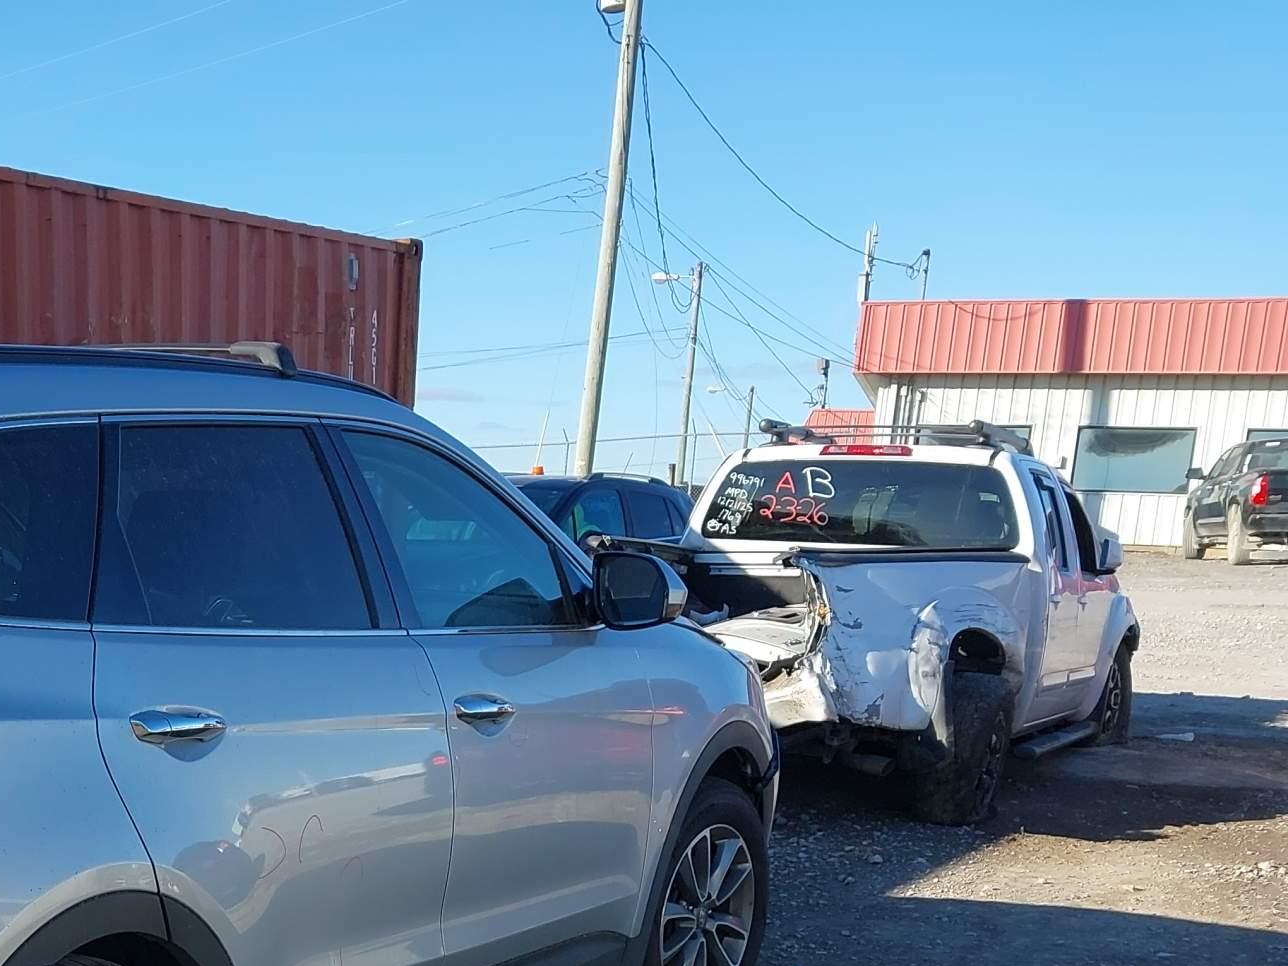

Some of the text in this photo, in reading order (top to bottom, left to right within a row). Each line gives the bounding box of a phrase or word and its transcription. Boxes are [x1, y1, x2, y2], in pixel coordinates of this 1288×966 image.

[776, 467, 835, 498] A B
[760, 495, 829, 525] 2-3-26
